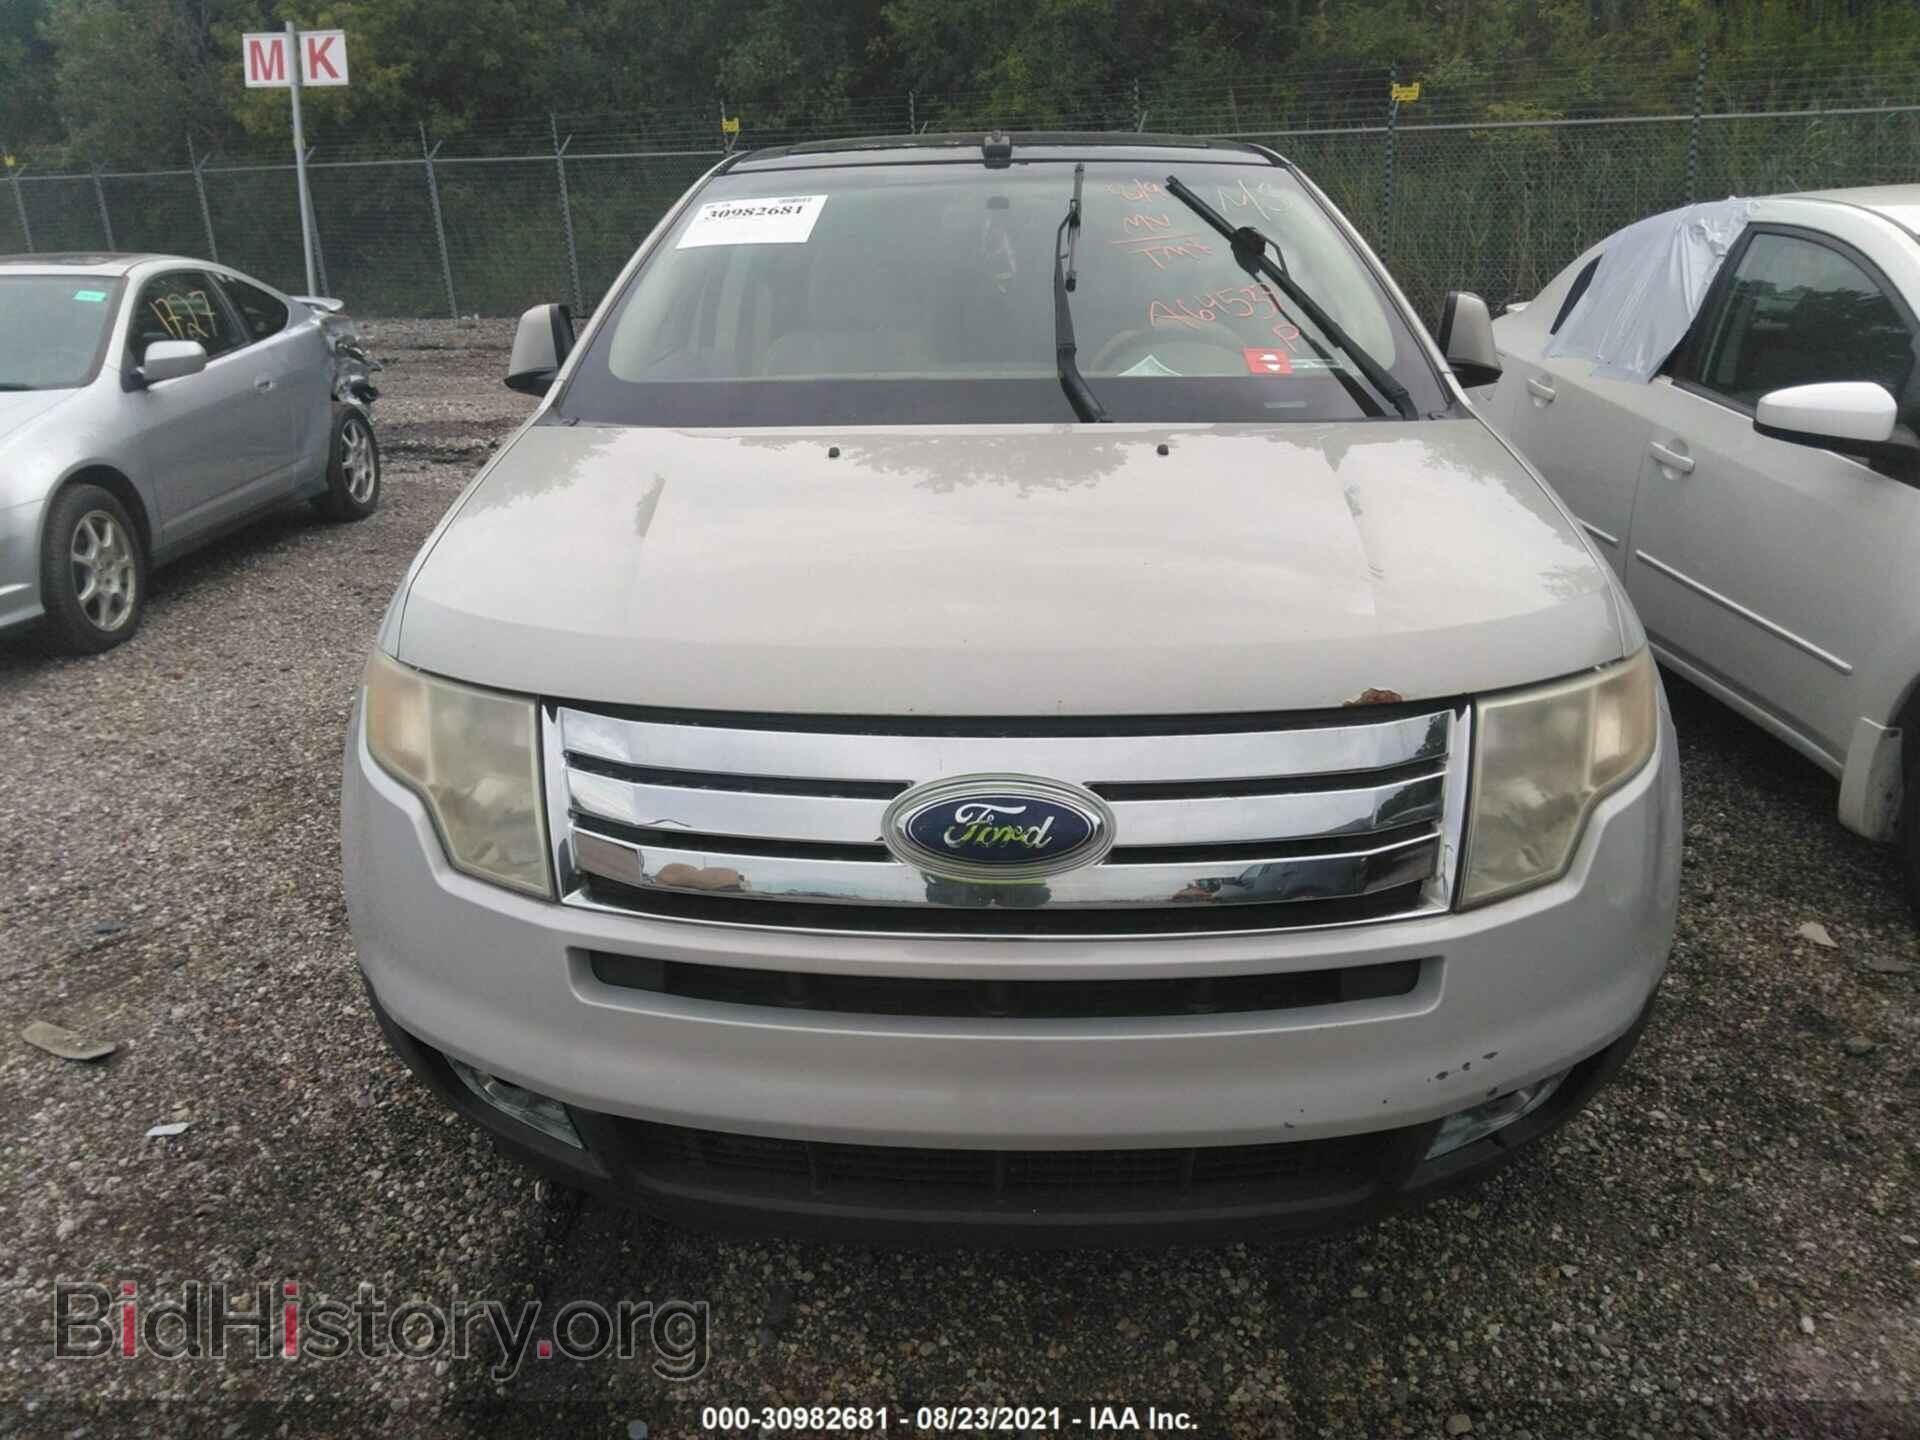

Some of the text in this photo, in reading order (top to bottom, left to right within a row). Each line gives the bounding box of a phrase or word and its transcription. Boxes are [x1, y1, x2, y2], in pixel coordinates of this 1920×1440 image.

[249, 36, 341, 81] M K
[710, 204, 804, 219] 30982681
[943, 802, 1056, 849] Ford
